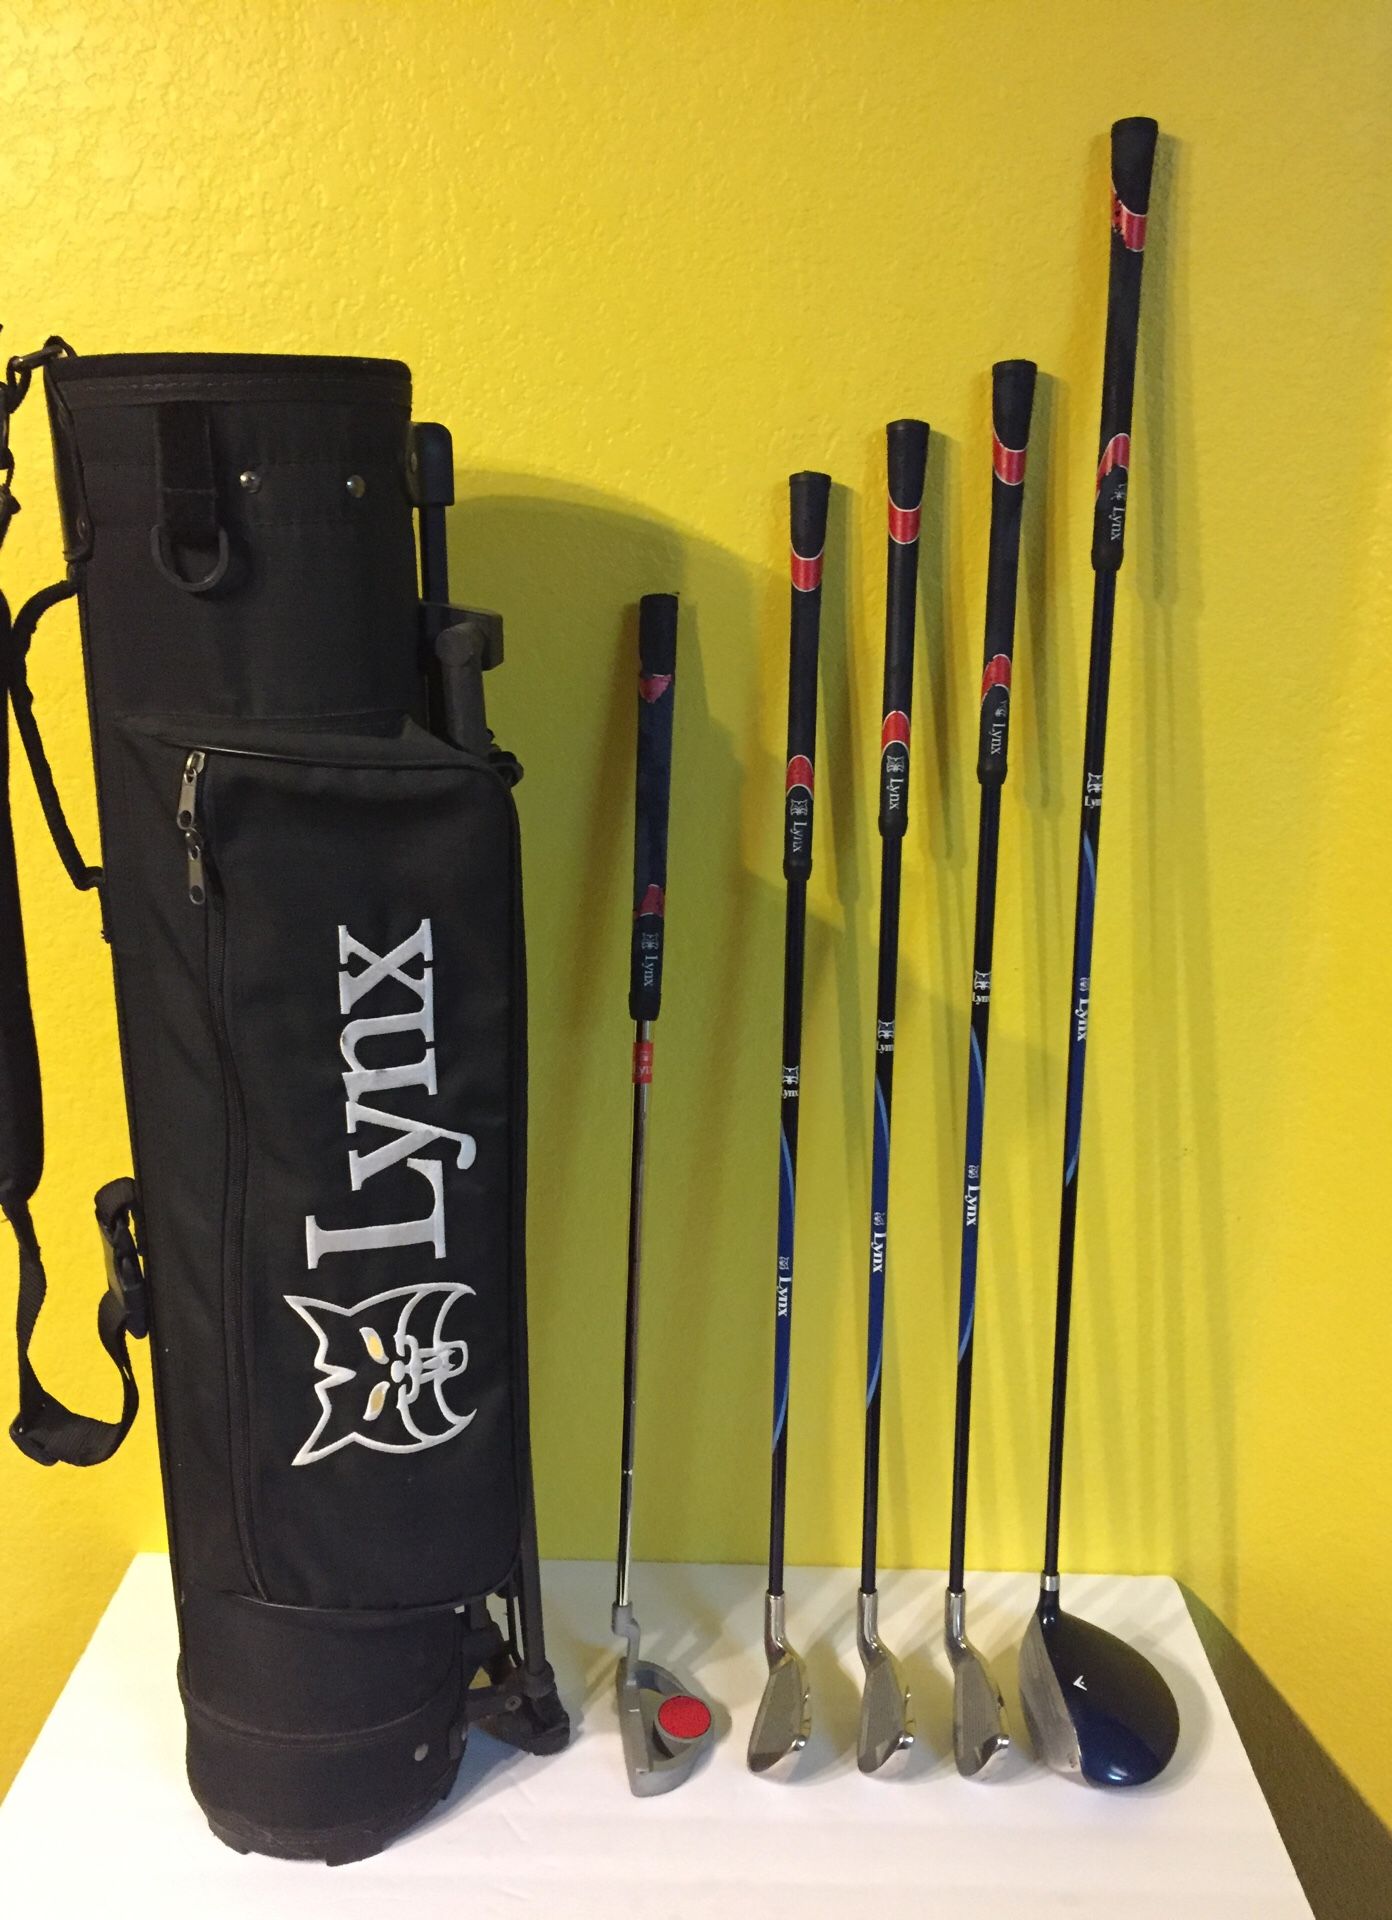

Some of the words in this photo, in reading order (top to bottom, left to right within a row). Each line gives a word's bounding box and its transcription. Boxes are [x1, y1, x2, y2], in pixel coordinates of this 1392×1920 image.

[1108, 506, 1126, 541] Lynx
[988, 723, 1006, 755] Lynx
[886, 778, 904, 810] Lynx
[790, 821, 808, 853] Lynx
[641, 955, 659, 987] Lynx
[1075, 998, 1090, 1042] Lynx
[306, 918, 477, 1270] Lynx
[964, 1185, 981, 1227] Lynx
[871, 1232, 887, 1273] Lynx
[776, 1276, 792, 1317] Lynx
